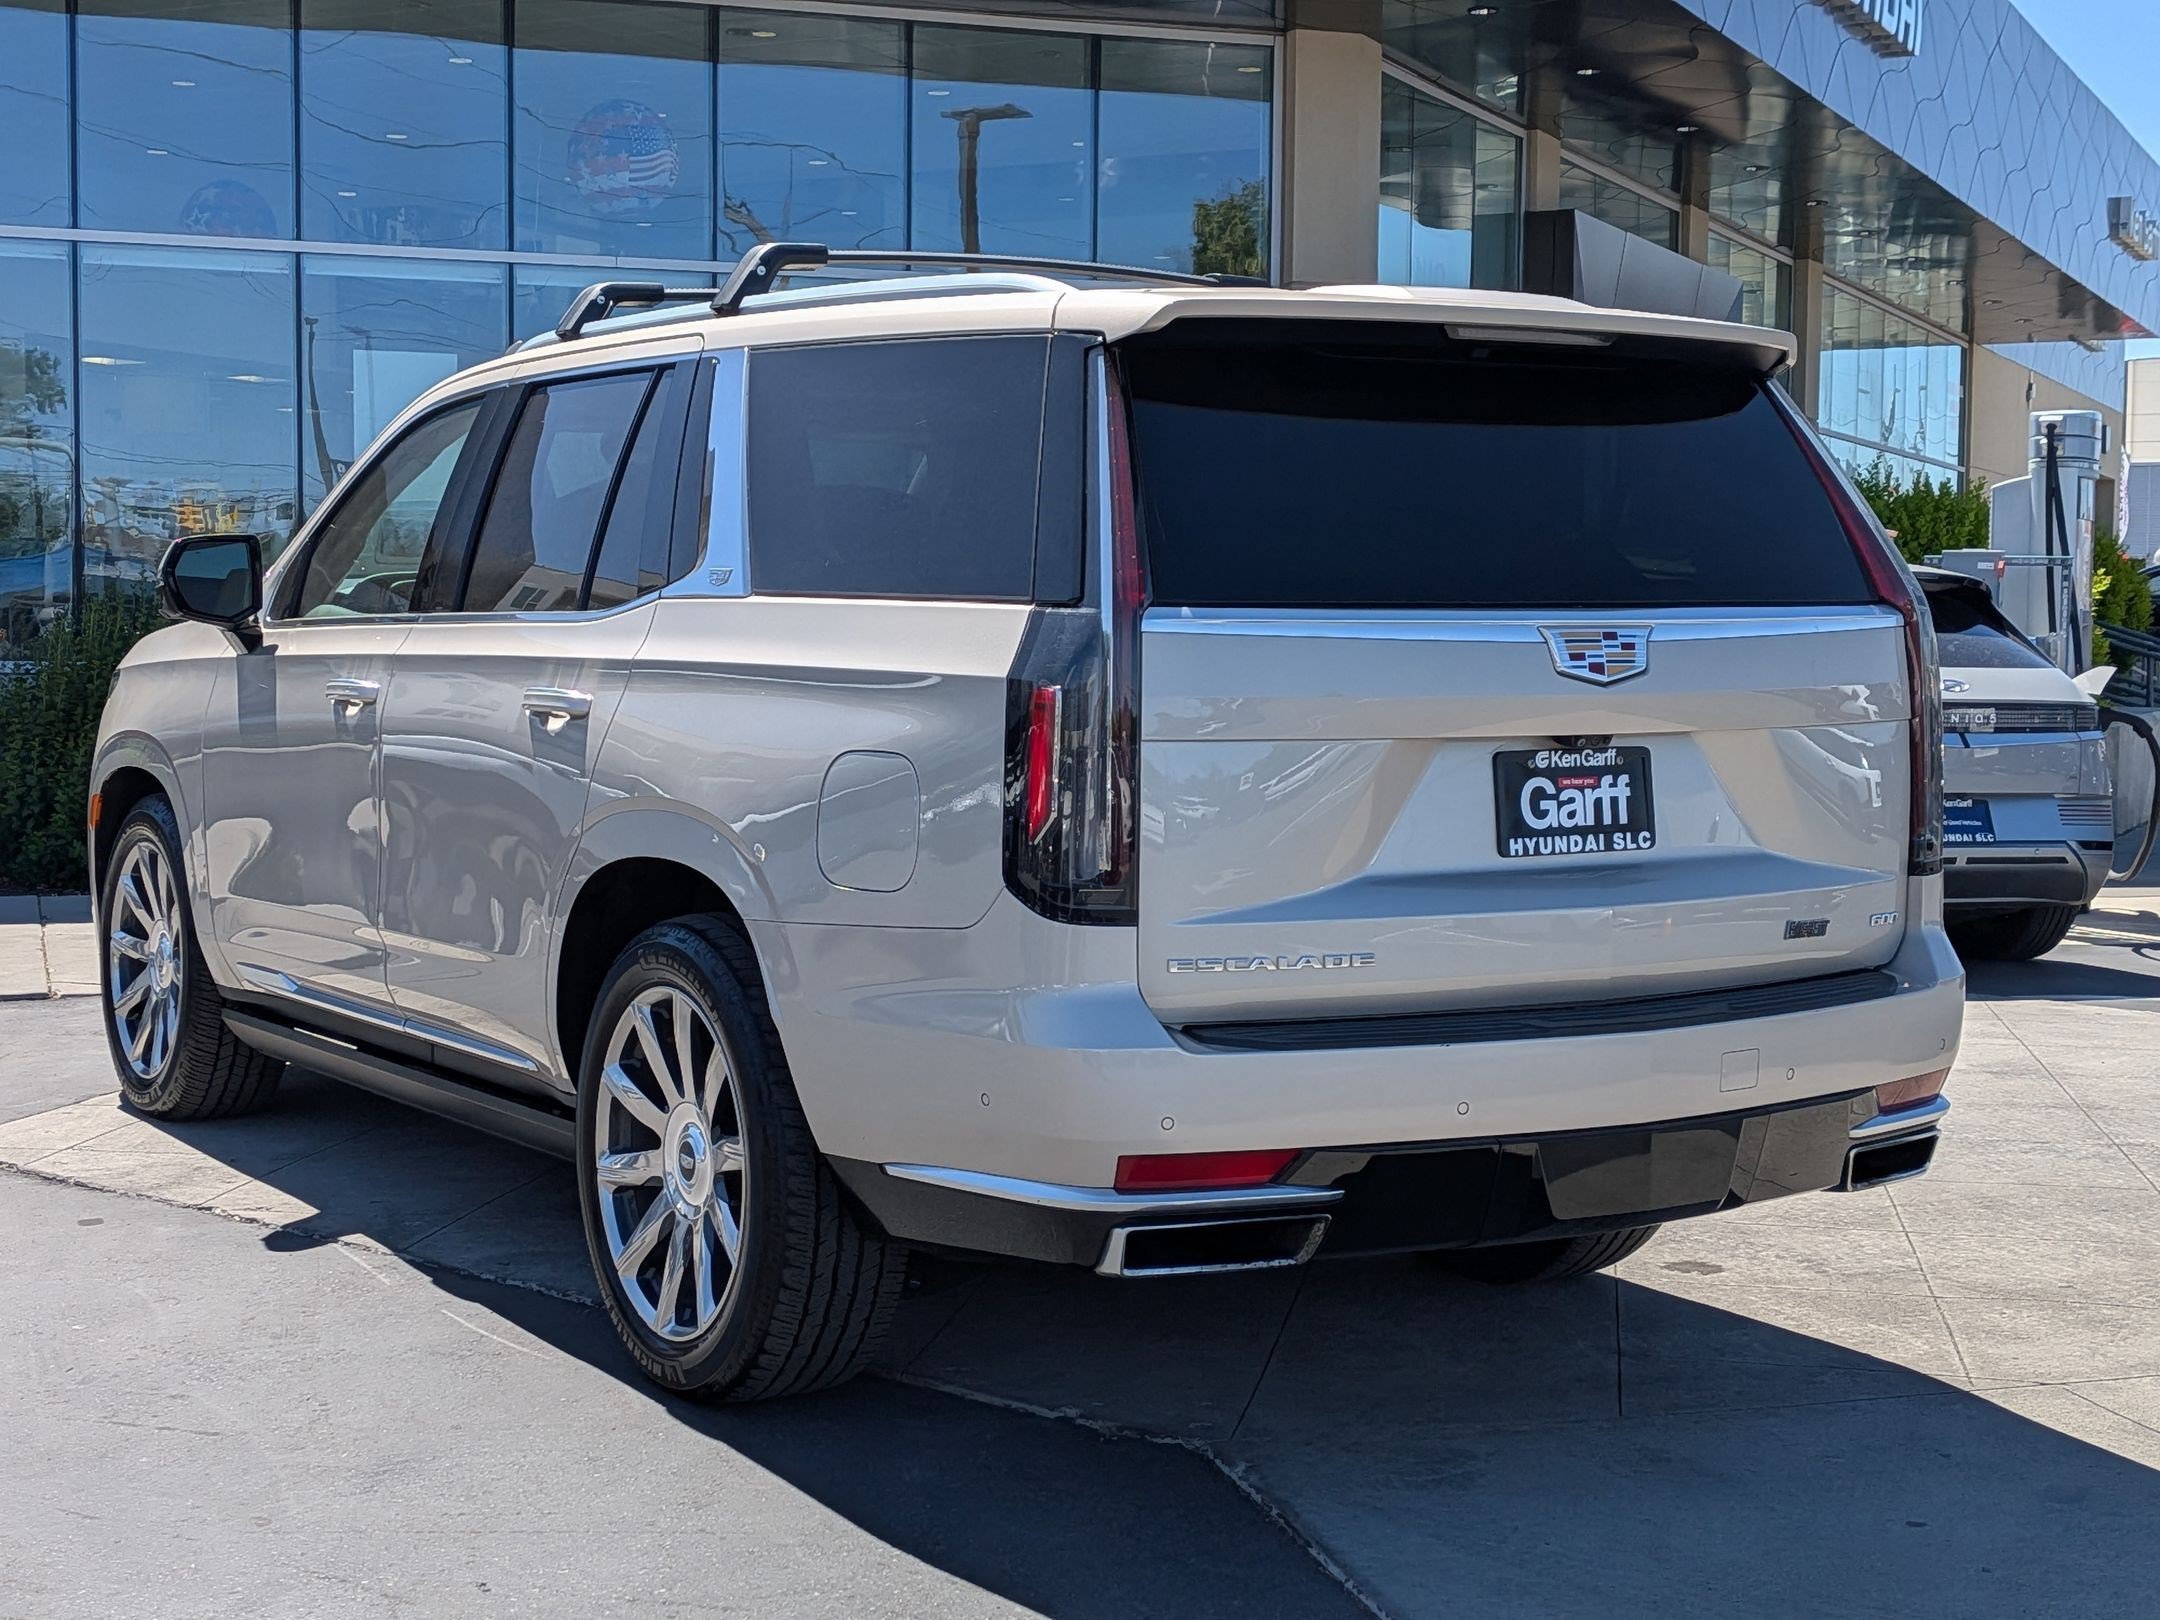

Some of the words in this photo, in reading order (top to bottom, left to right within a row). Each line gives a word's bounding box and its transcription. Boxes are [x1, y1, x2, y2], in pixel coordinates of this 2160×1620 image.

[1520, 774, 1631, 830] Garff
[1509, 833, 1605, 857] HYUNDAI
[1612, 830, 1652, 850] SLC
[1975, 832, 1995, 842] SLC
[1166, 952, 1377, 974] ESCALADE
